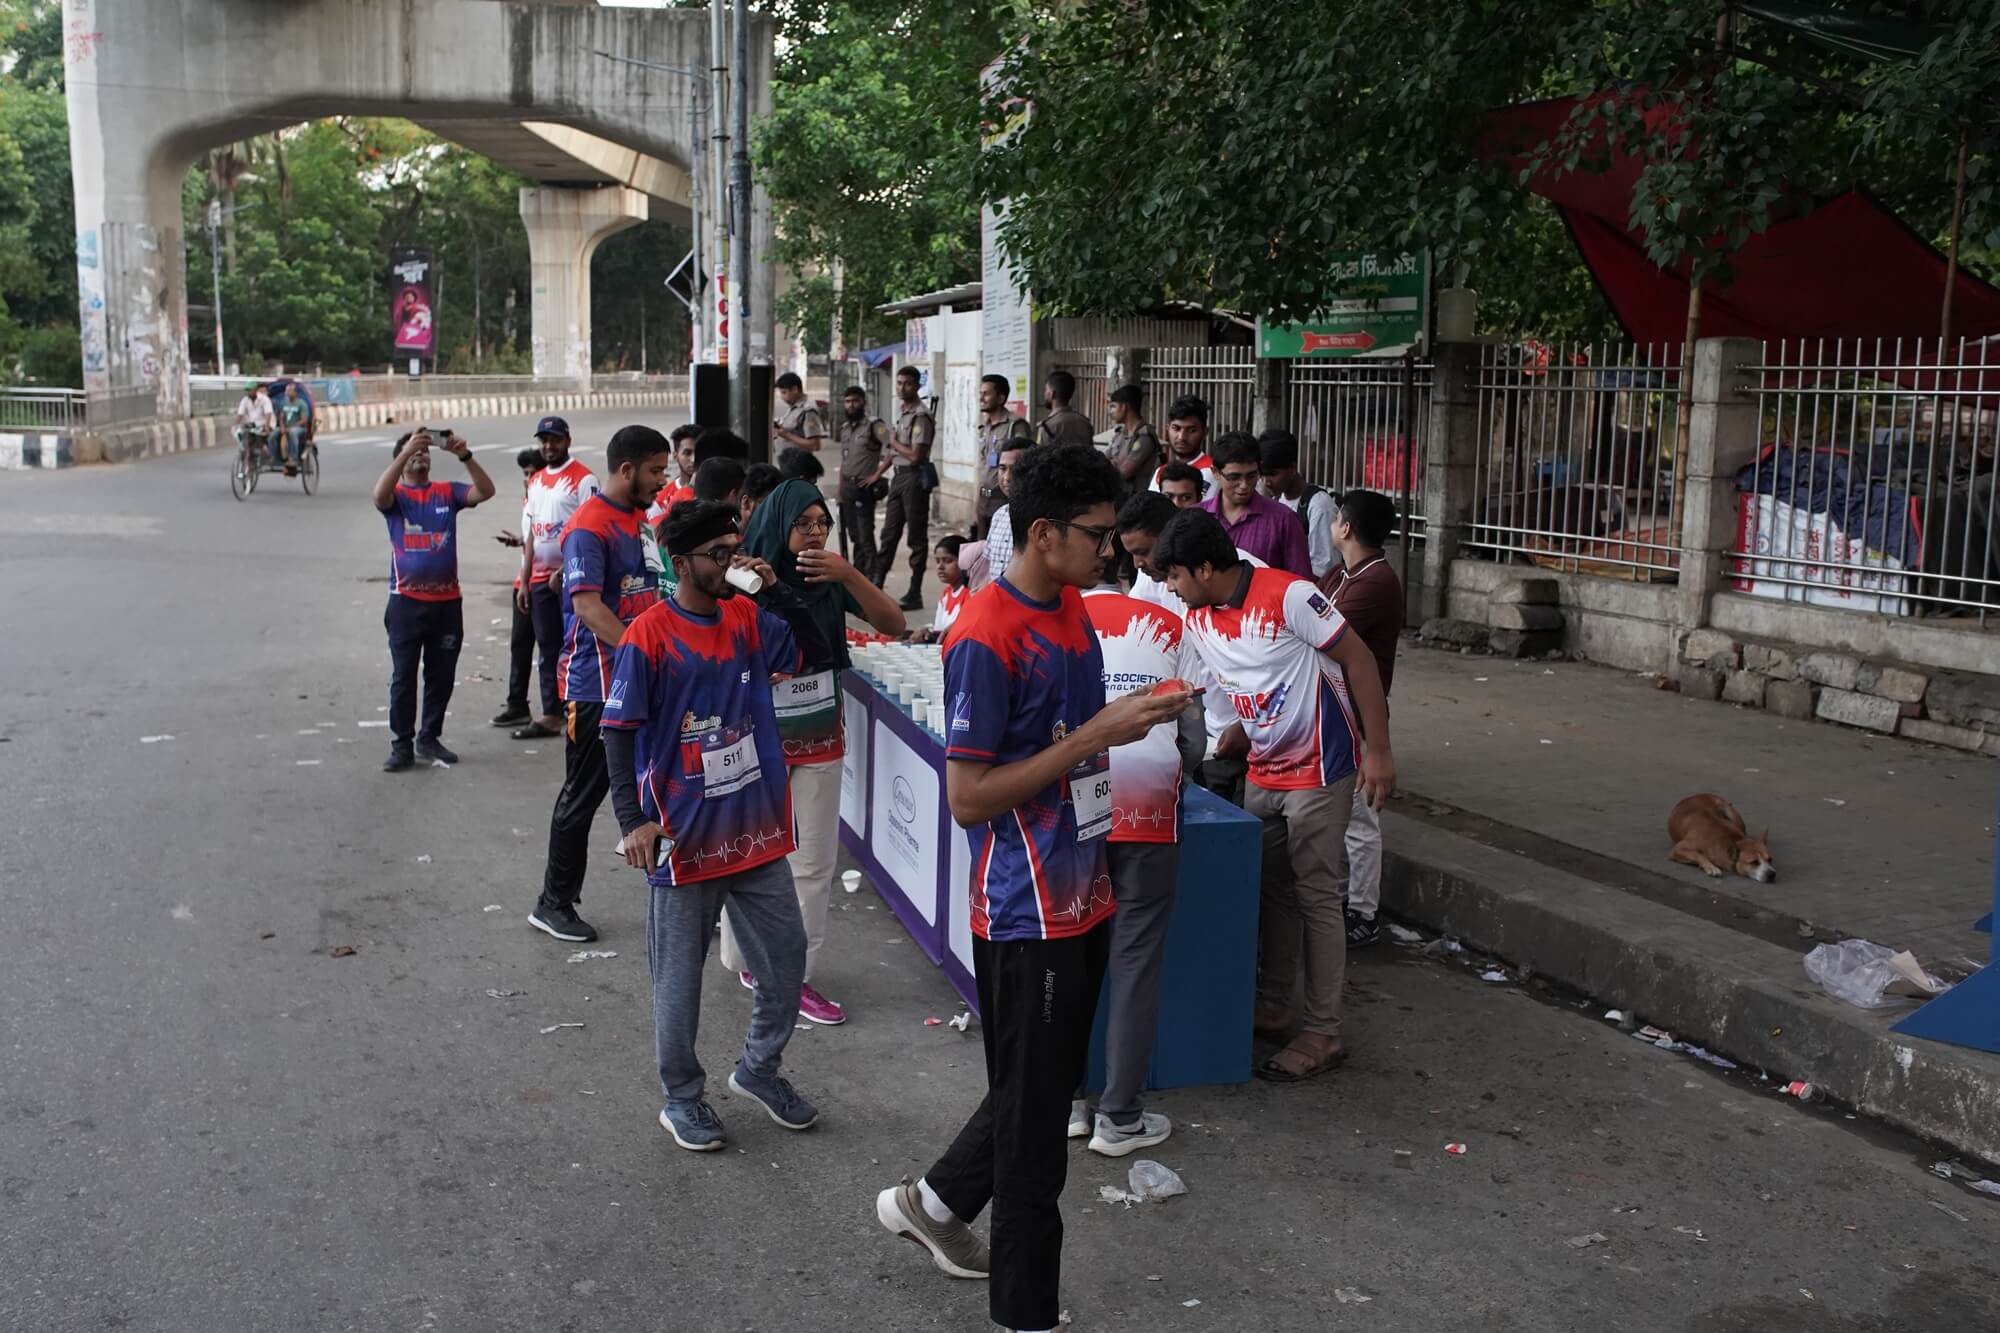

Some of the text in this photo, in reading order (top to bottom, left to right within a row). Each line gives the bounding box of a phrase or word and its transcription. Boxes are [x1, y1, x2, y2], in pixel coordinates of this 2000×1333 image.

[1112, 673, 1163, 684] SOCIETY
[791, 680, 819, 694] 2068
[1094, 780, 1112, 799] 60
